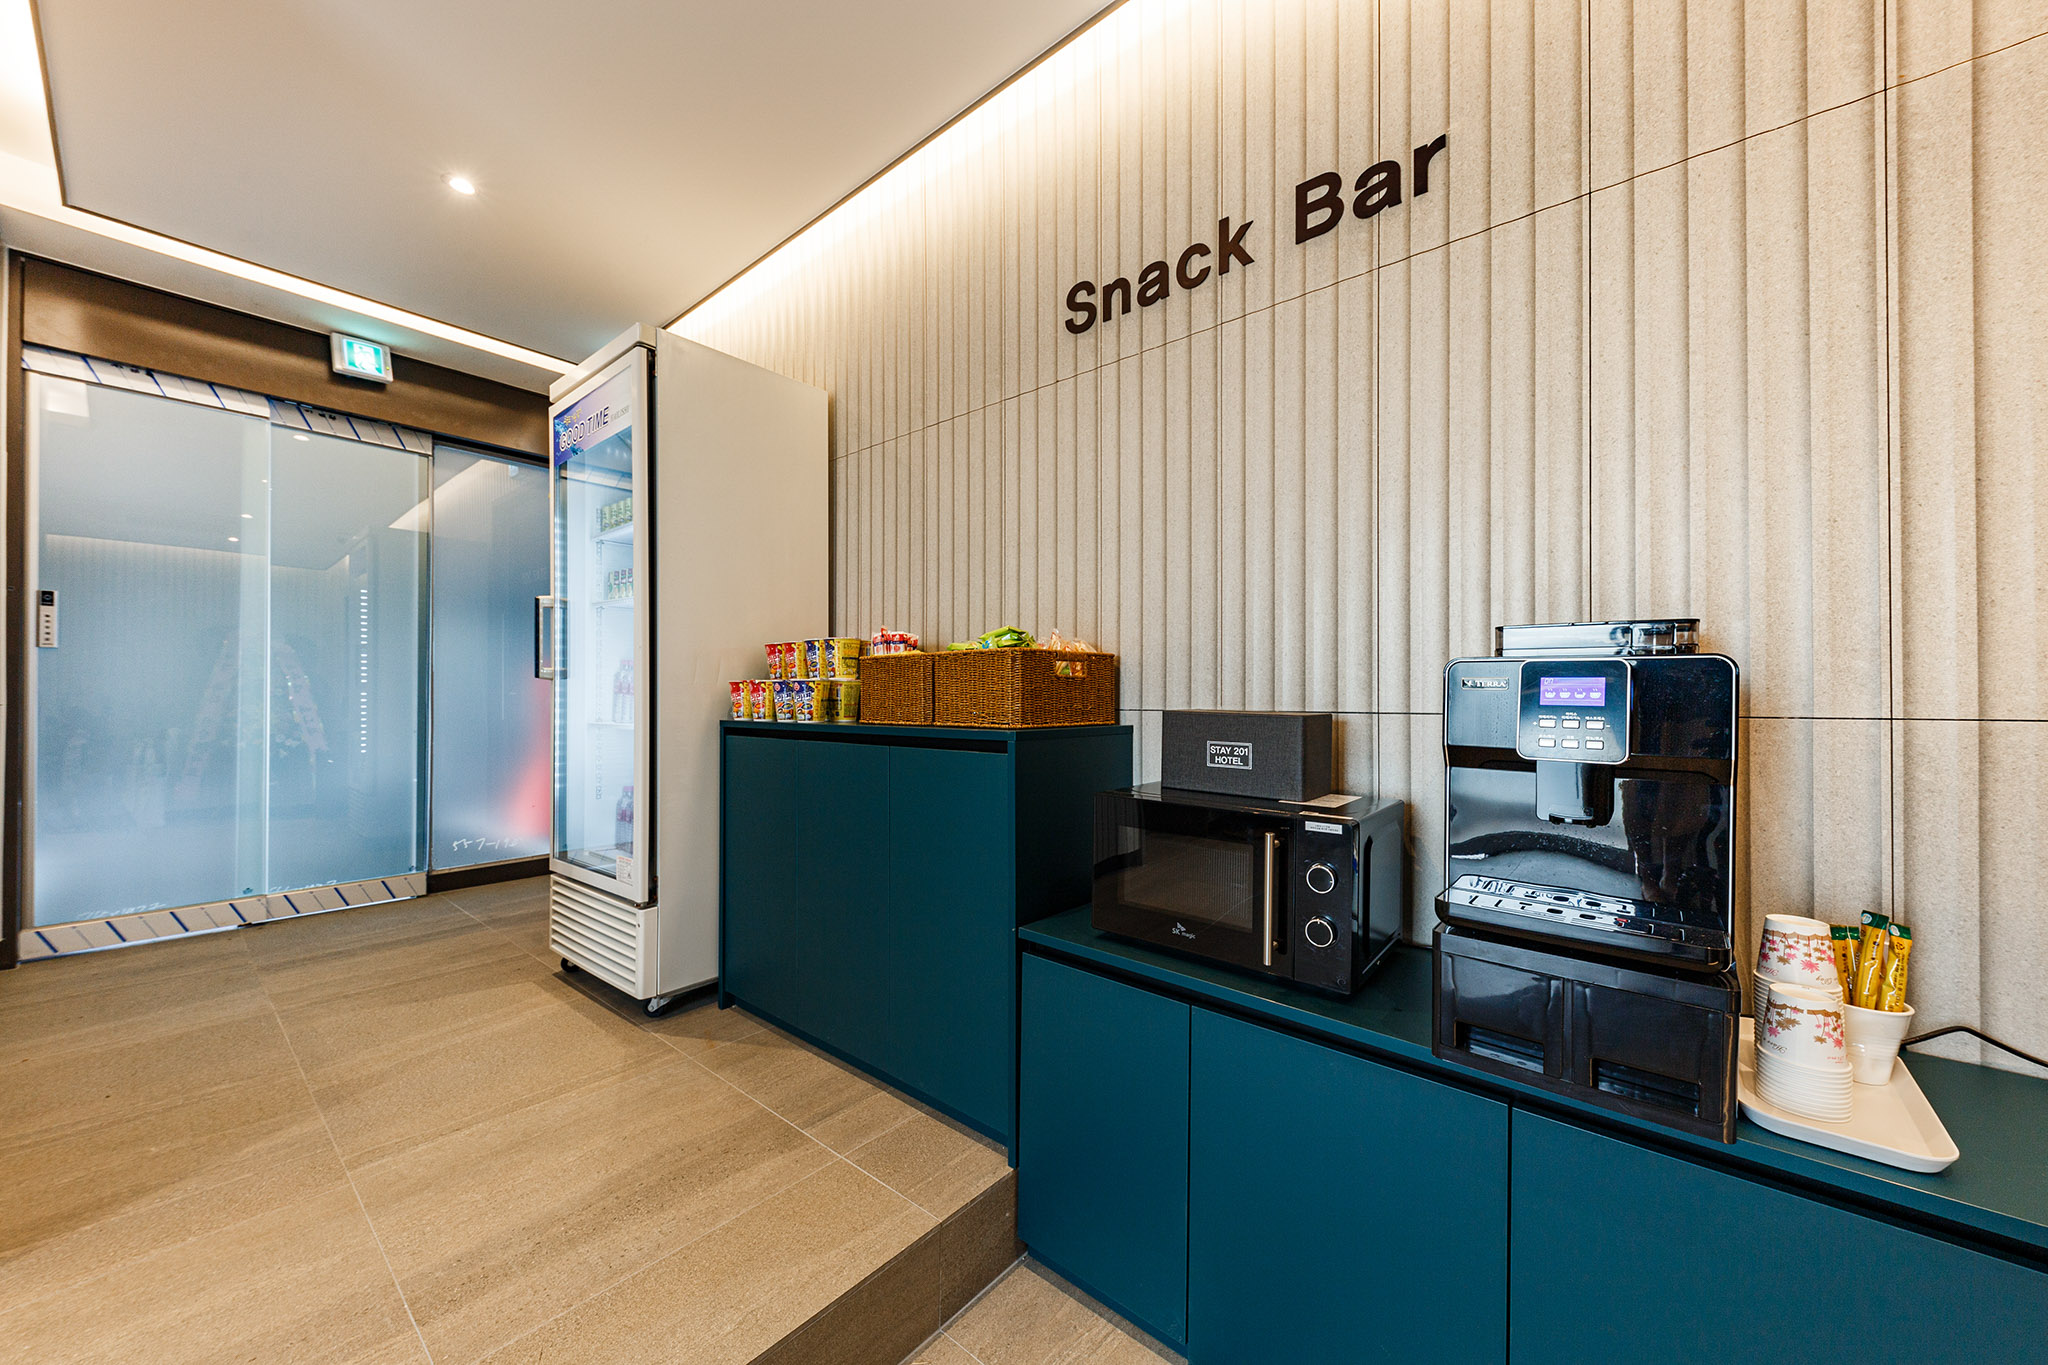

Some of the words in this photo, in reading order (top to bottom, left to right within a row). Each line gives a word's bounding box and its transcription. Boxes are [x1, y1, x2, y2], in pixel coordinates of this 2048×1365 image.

[1065, 216, 1255, 334] Snack
[1295, 133, 1447, 245] Bar
[559, 421, 585, 451] GOOD
[587, 406, 609, 434] TIME
[1210, 745, 1232, 755] STAY
[1233, 747, 1249, 756] 201
[1215, 756, 1243, 766] HOTEL
[1171, 927, 1181, 936] SK
